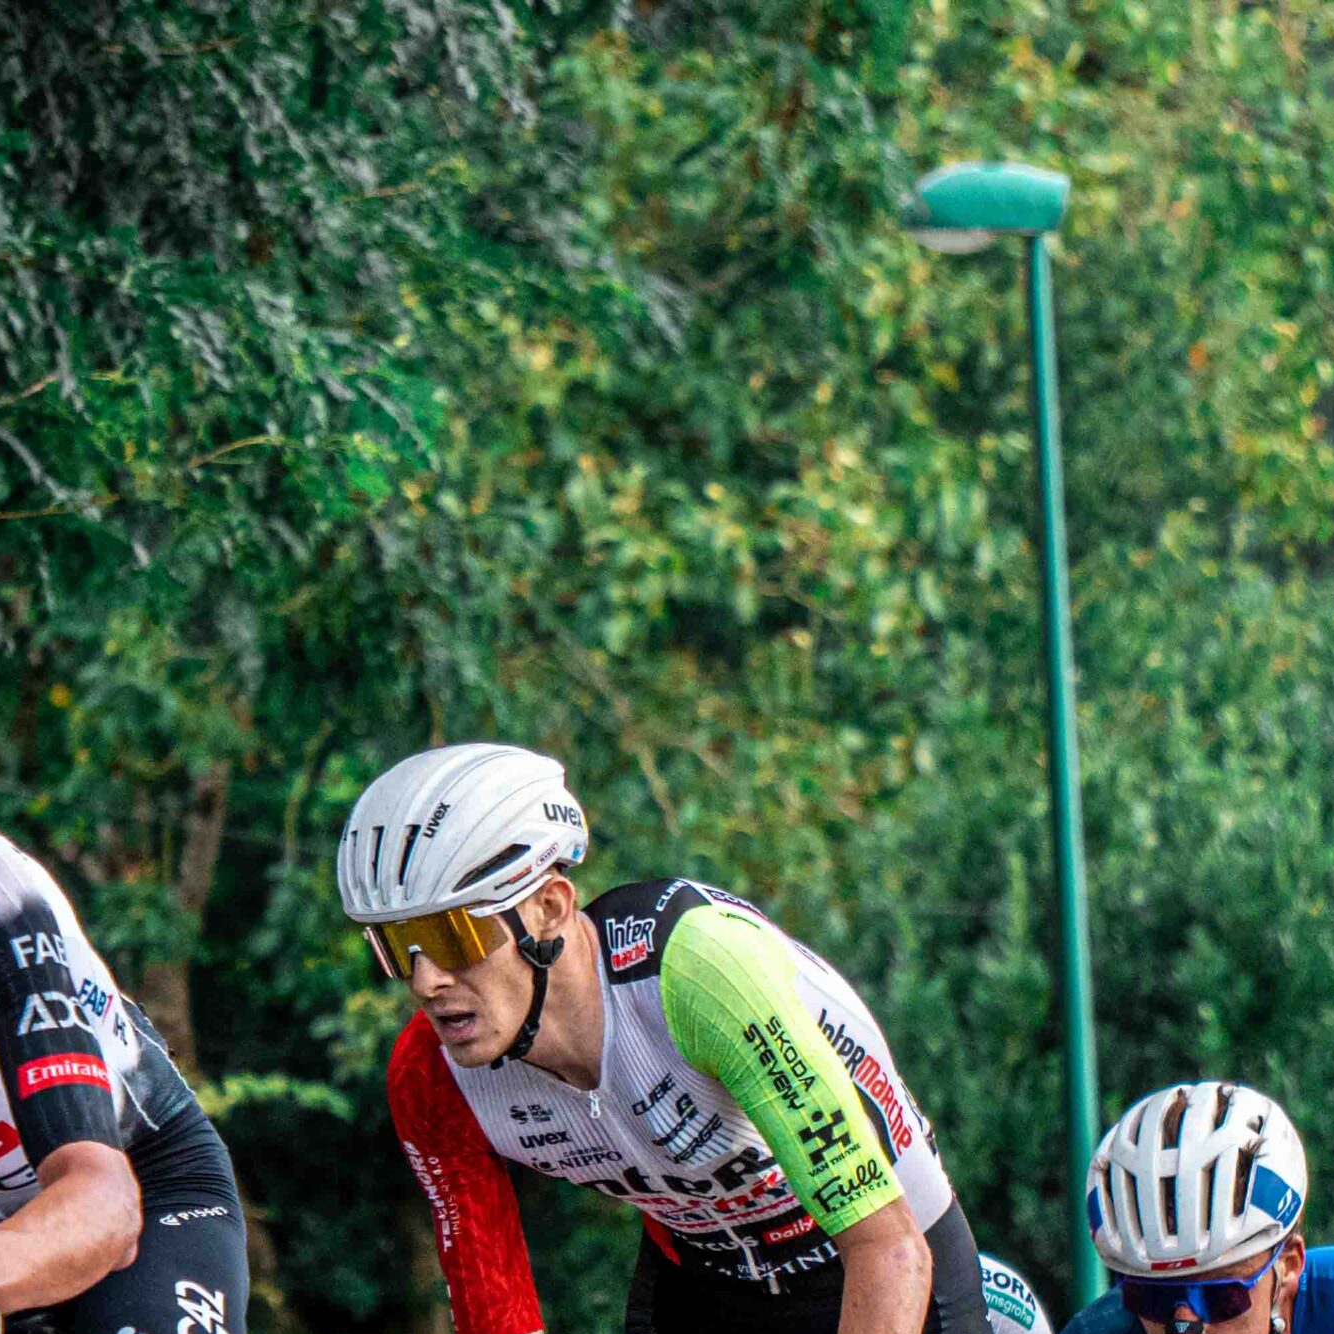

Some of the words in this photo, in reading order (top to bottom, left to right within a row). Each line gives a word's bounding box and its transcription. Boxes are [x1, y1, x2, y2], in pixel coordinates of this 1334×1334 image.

[423, 801, 451, 839] uvex
[542, 802, 583, 829] uvex
[519, 1131, 572, 1149] uvex
[558, 1150, 623, 1170] NIPPO
[812, 1159, 884, 1214] Full
[769, 1219, 815, 1243] Daily
